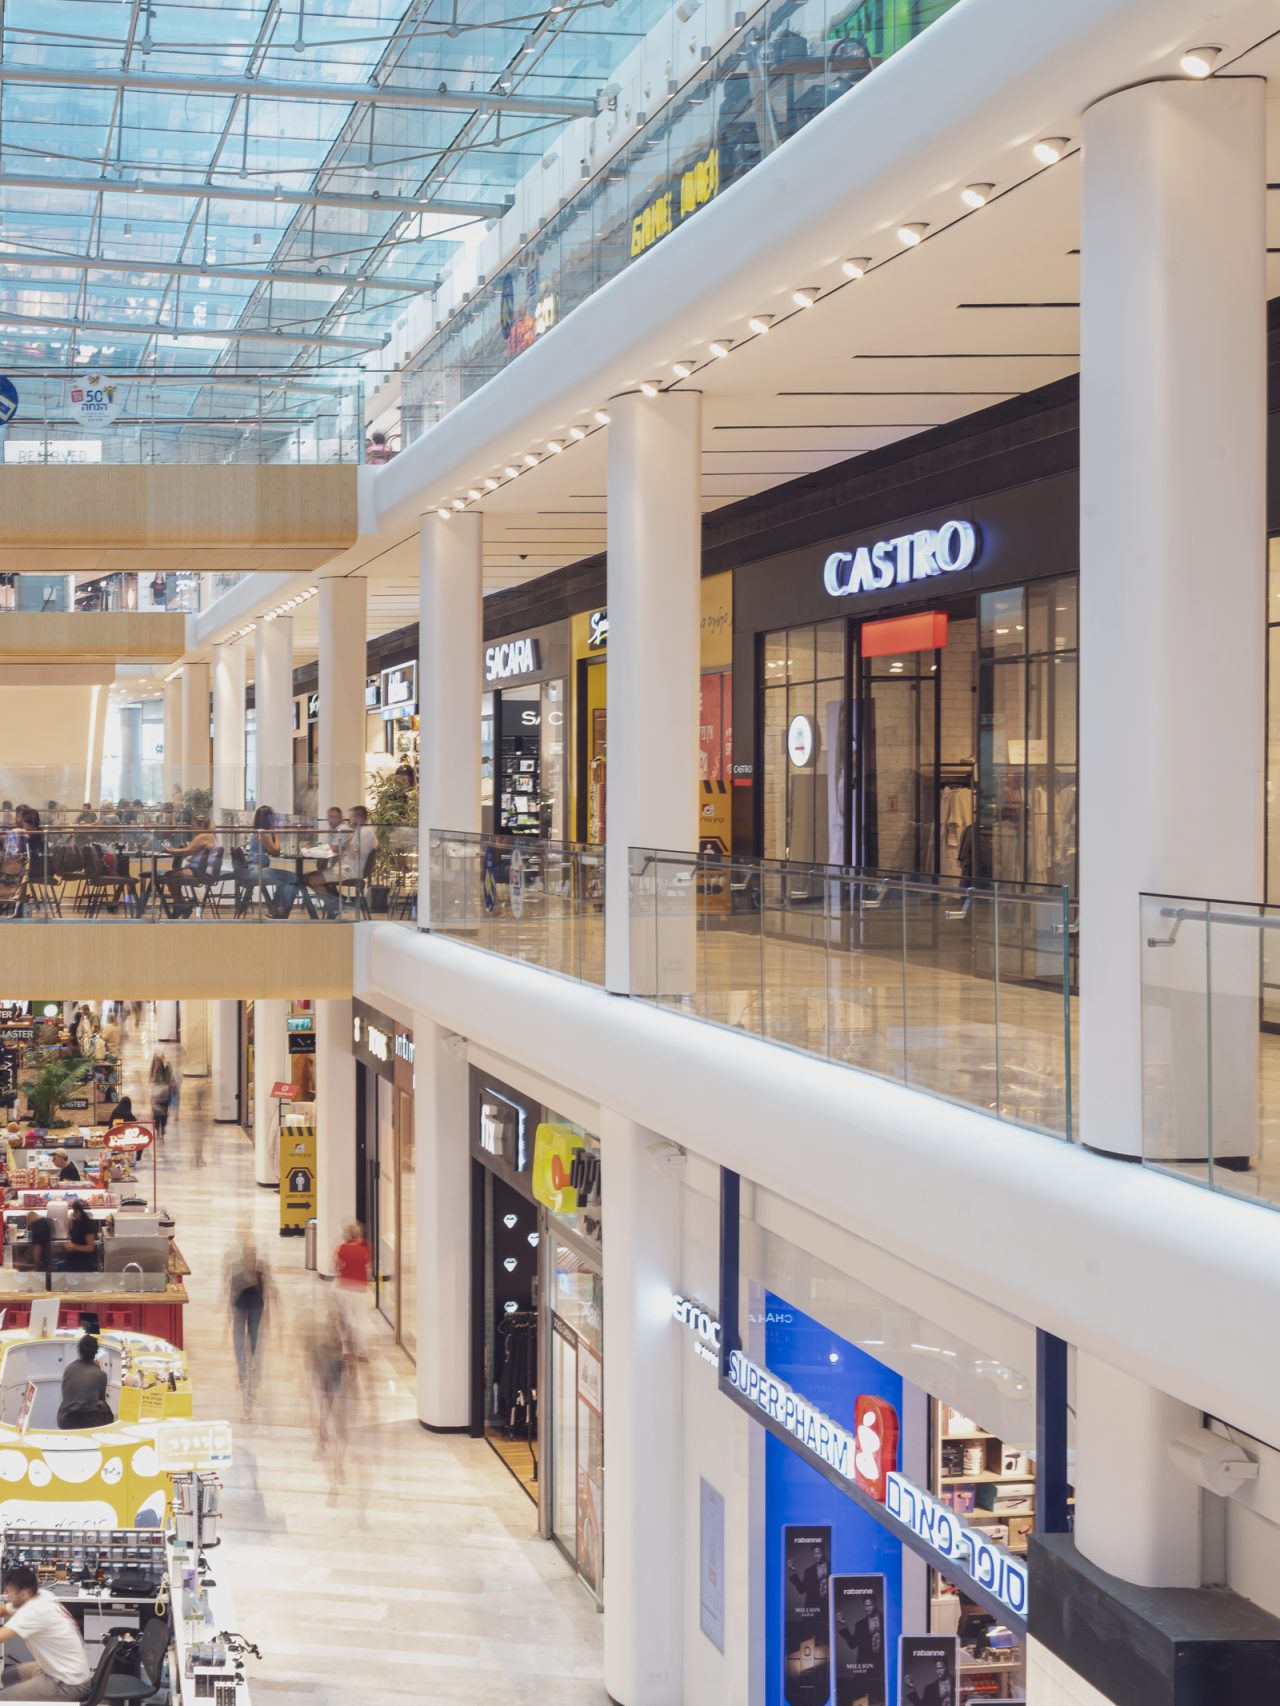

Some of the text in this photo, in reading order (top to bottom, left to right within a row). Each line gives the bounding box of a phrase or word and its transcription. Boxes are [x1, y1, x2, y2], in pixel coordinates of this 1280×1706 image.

[824, 520, 975, 597] CASTRO
[486, 638, 533, 681] SACARA
[733, 765, 752, 774] CASTRO
[2, 1030, 34, 1038] LASTER
[913, 1649, 945, 1657] rabanne
